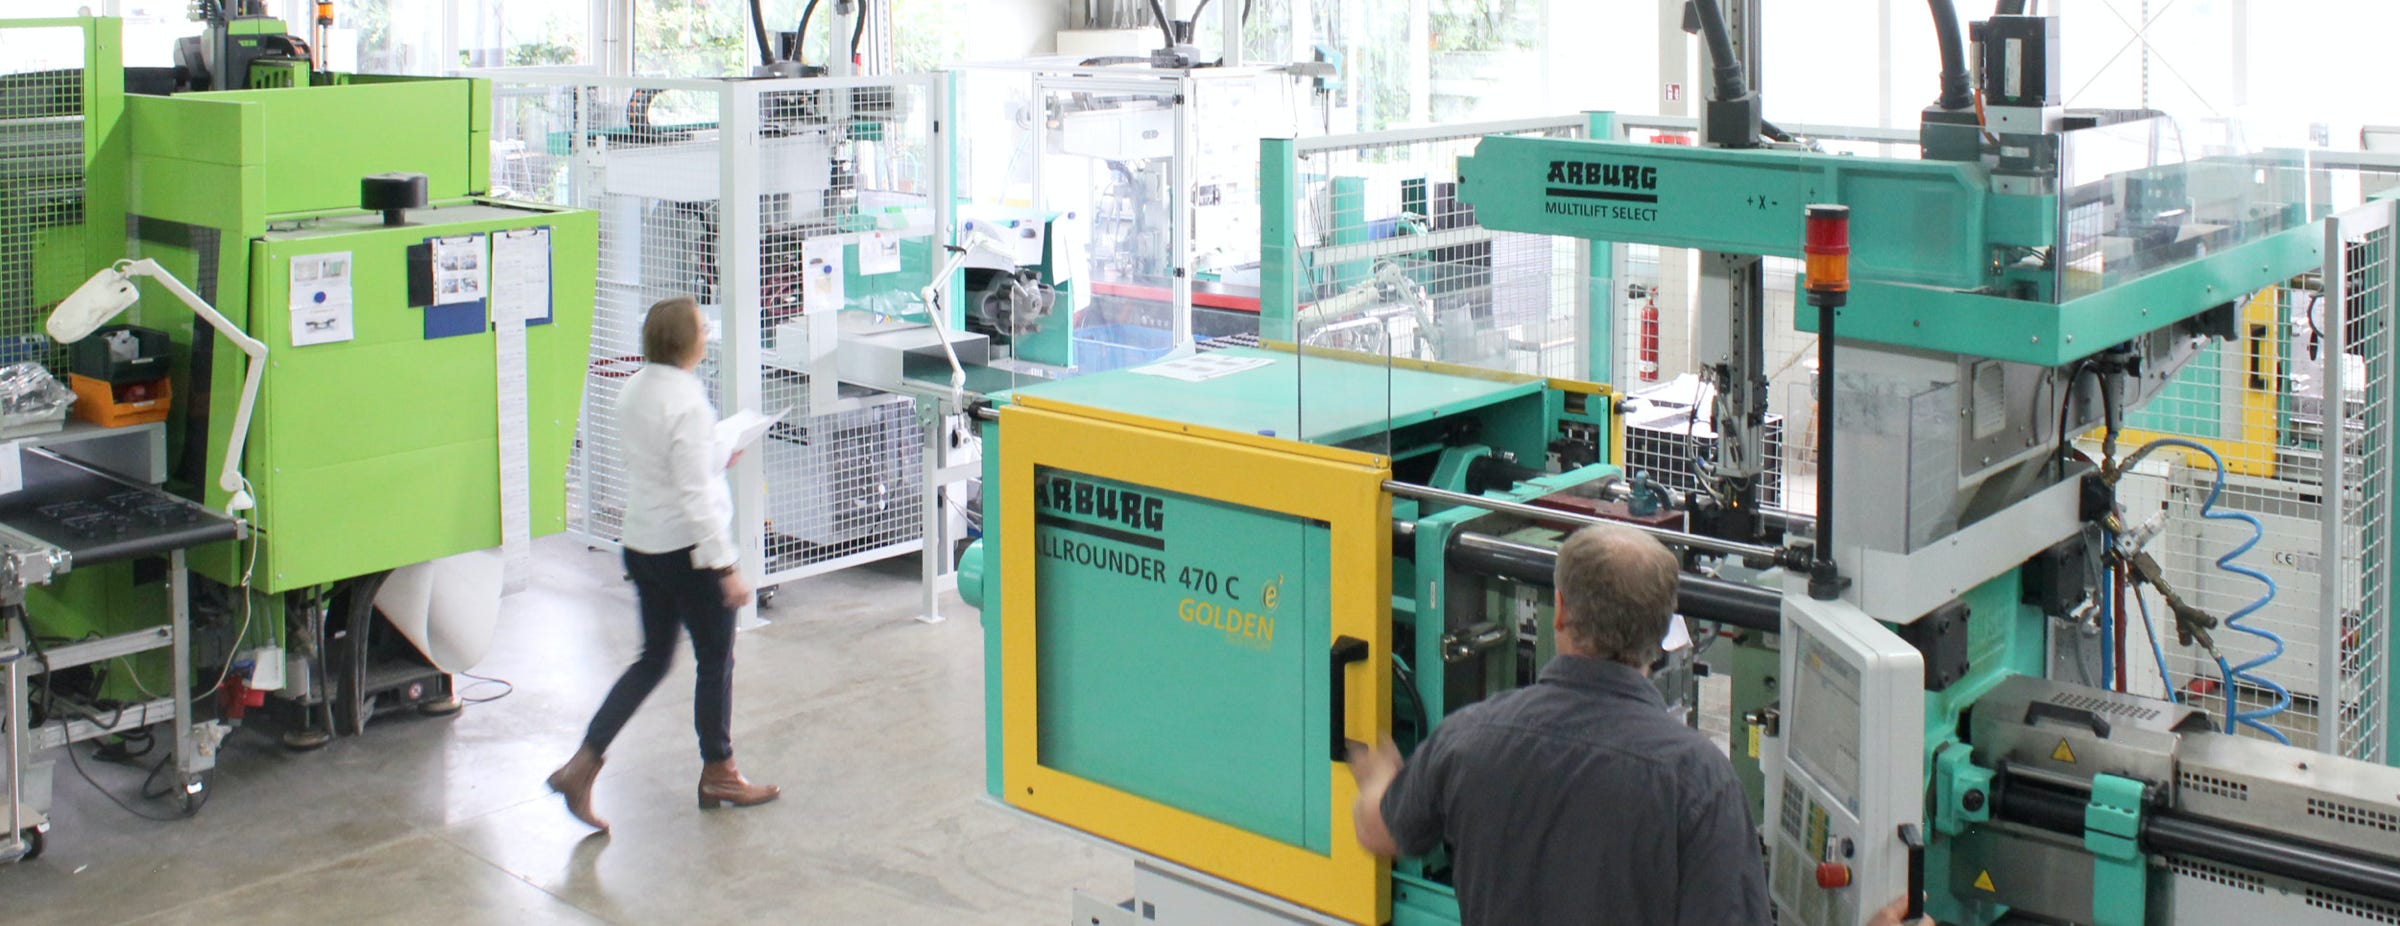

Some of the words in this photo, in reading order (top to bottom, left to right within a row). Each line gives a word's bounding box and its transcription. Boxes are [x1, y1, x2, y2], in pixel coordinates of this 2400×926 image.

[1547, 160, 1657, 190] ARBURG
[1545, 201, 1608, 218] MULTILIFT
[1612, 206, 1658, 222] SELECT
[1758, 194, 1767, 210] X
[1037, 534, 1166, 583] LLROUNDER
[1179, 565, 1218, 595] 470
[1225, 575, 1240, 601] C
[1178, 597, 1275, 641] GOLDEN
